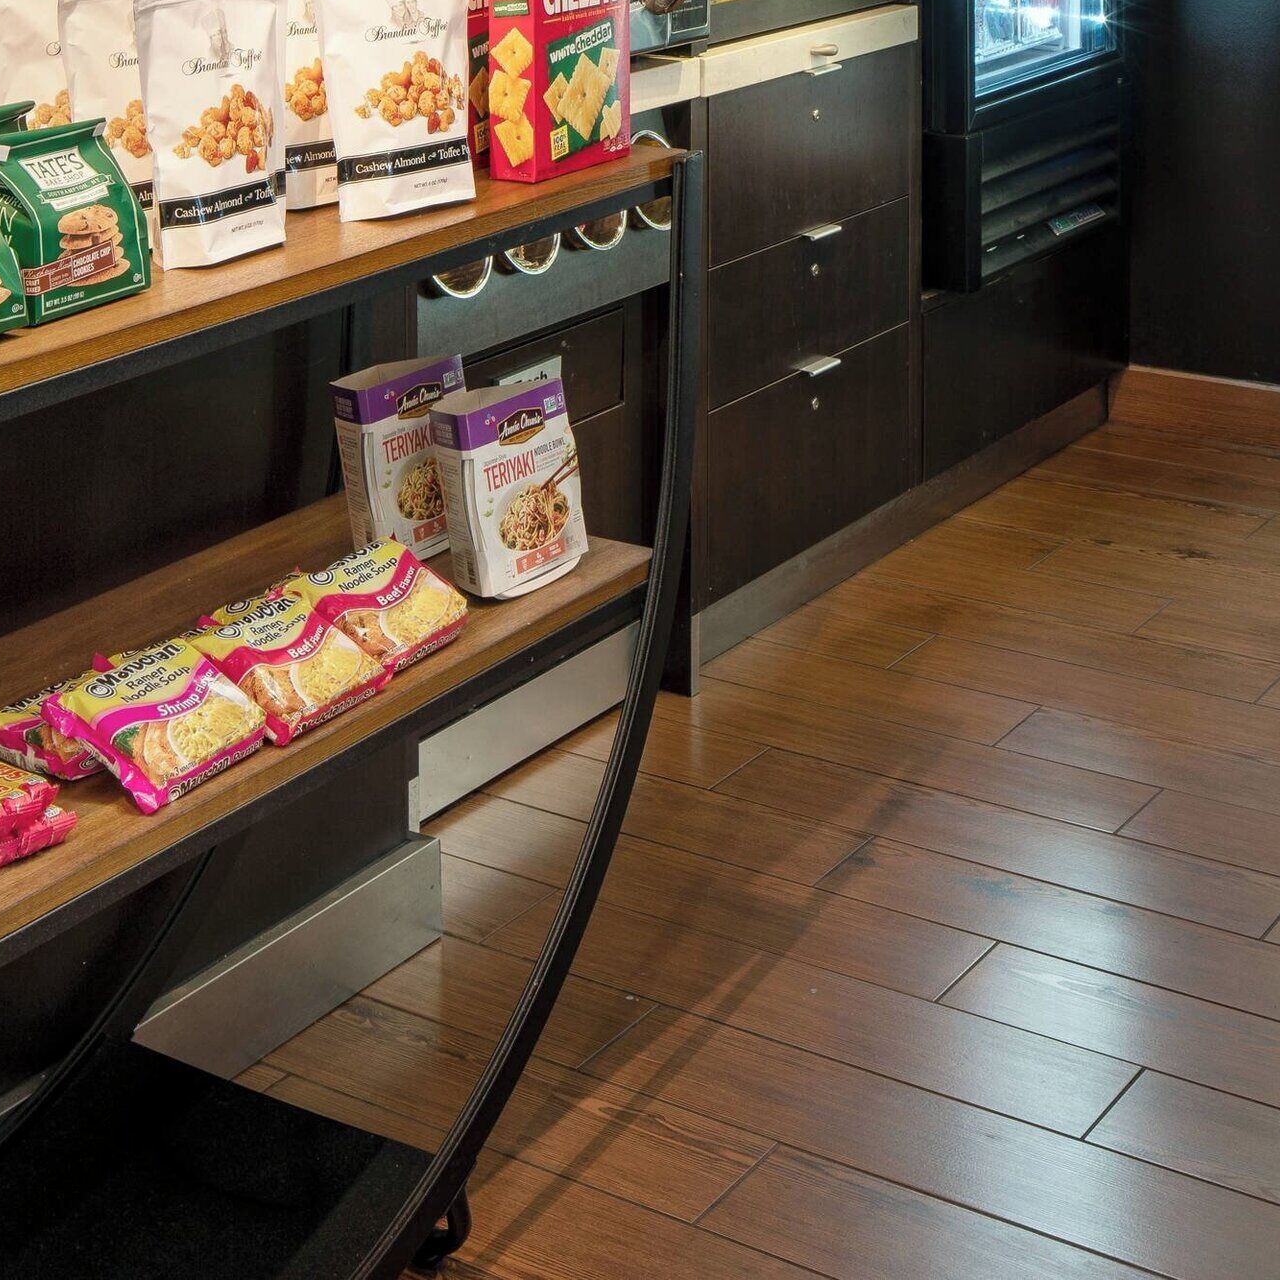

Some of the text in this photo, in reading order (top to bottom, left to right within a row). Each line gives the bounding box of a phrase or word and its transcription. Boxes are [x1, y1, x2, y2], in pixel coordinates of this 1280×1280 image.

[365, 17, 447, 43] Brandini Toffee
[575, 23, 611, 52] cheddar
[25, 153, 84, 179] TATE'S
[304, 149, 336, 163] Almond
[355, 148, 461, 174] Cashew Almond Toffee
[63, 172, 84, 183] SHOP
[174, 197, 243, 219] Cashew Almond
[73, 246, 111, 268] CHOCOLATE CHIP
[382, 422, 433, 463] TERIYAKI
[534, 441, 552, 455] NOODLE
[483, 450, 536, 492] TERIYAKI
[338, 573, 373, 593] Noodle
[373, 556, 398, 577] Soup
[343, 558, 377, 578] Ramen
[375, 566, 416, 606] Beef Flavor
[250, 620, 285, 636] Ramen
[277, 613, 307, 634] Soup
[287, 639, 313, 659] Beef
[121, 665, 191, 703] Noodle Soup
[126, 665, 167, 689] Ramen
[157, 693, 200, 717] Shrimp
